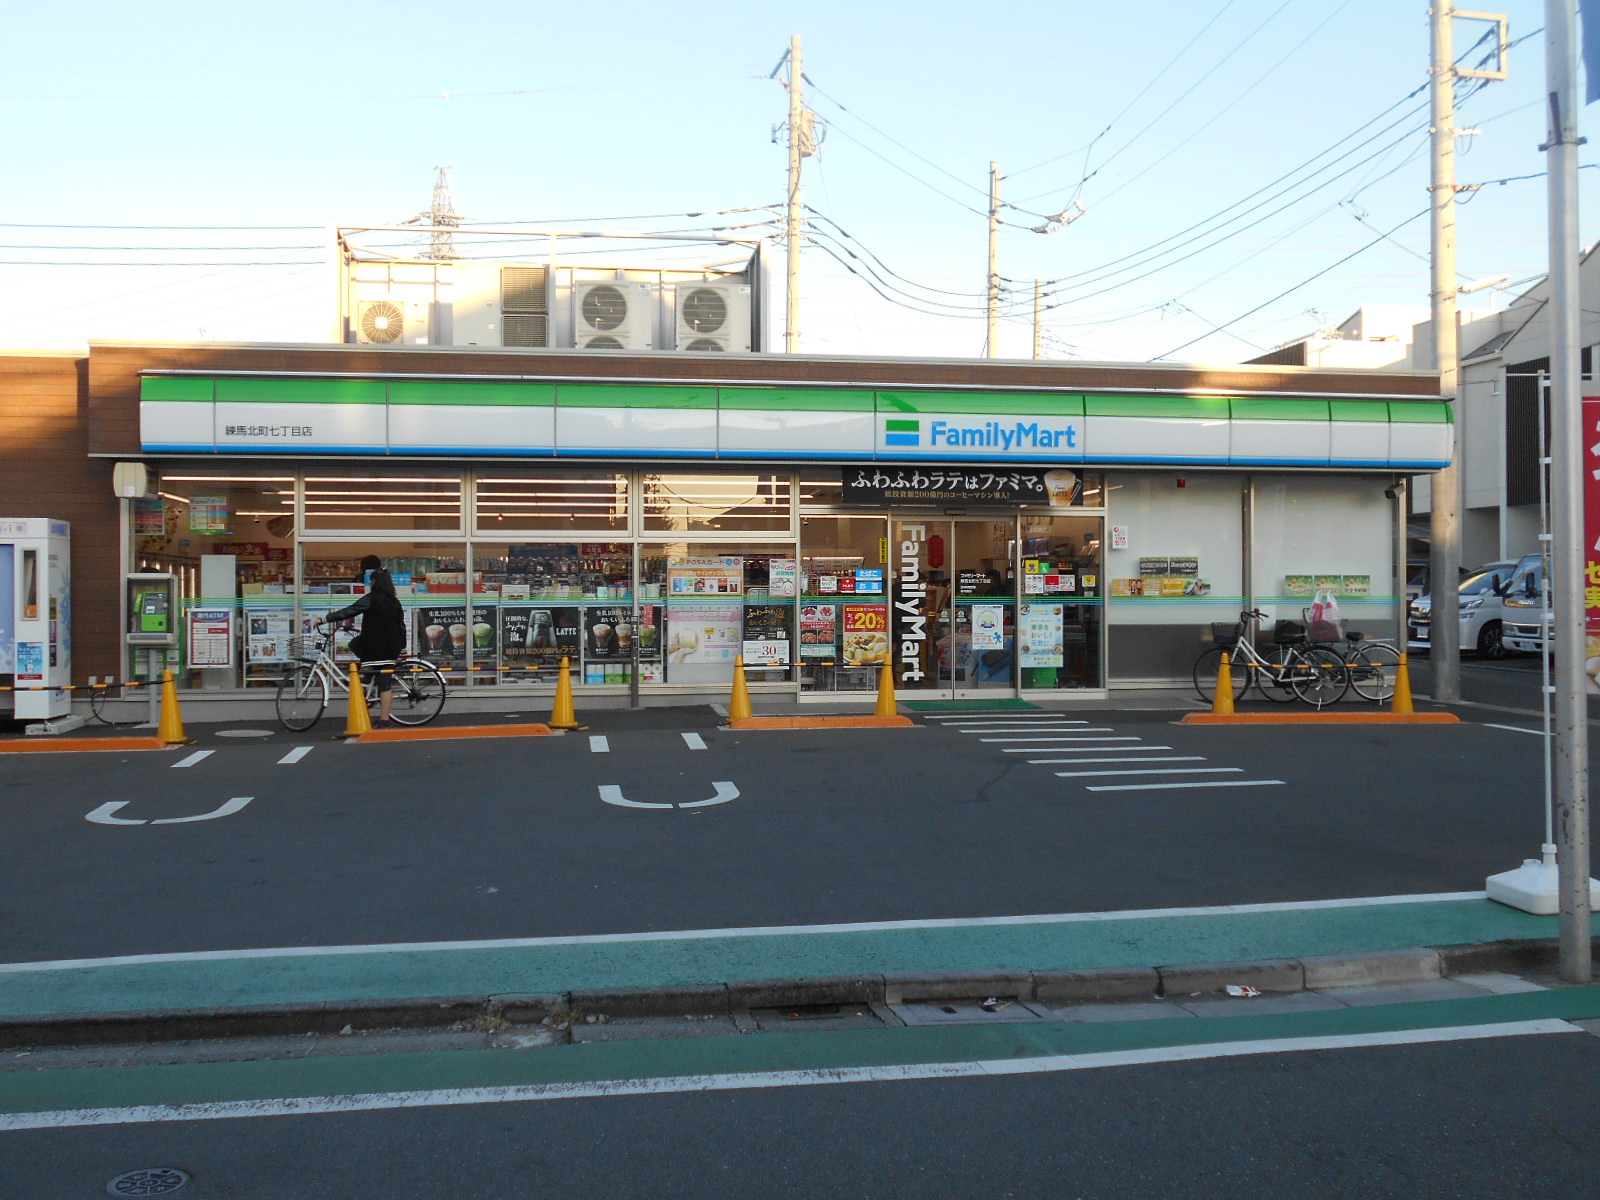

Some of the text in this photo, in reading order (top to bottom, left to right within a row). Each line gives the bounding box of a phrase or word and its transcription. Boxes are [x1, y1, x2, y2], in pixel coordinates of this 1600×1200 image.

[225, 425, 313, 437] 練馬北町七丁目店
[931, 421, 1076, 450] FamilyMart
[851, 470, 1044, 492] ふわふわラテはファミマ。
[895, 525, 927, 682] FamilyMart
[556, 627, 577, 636] LATTE
[762, 645, 777, 656] 30
